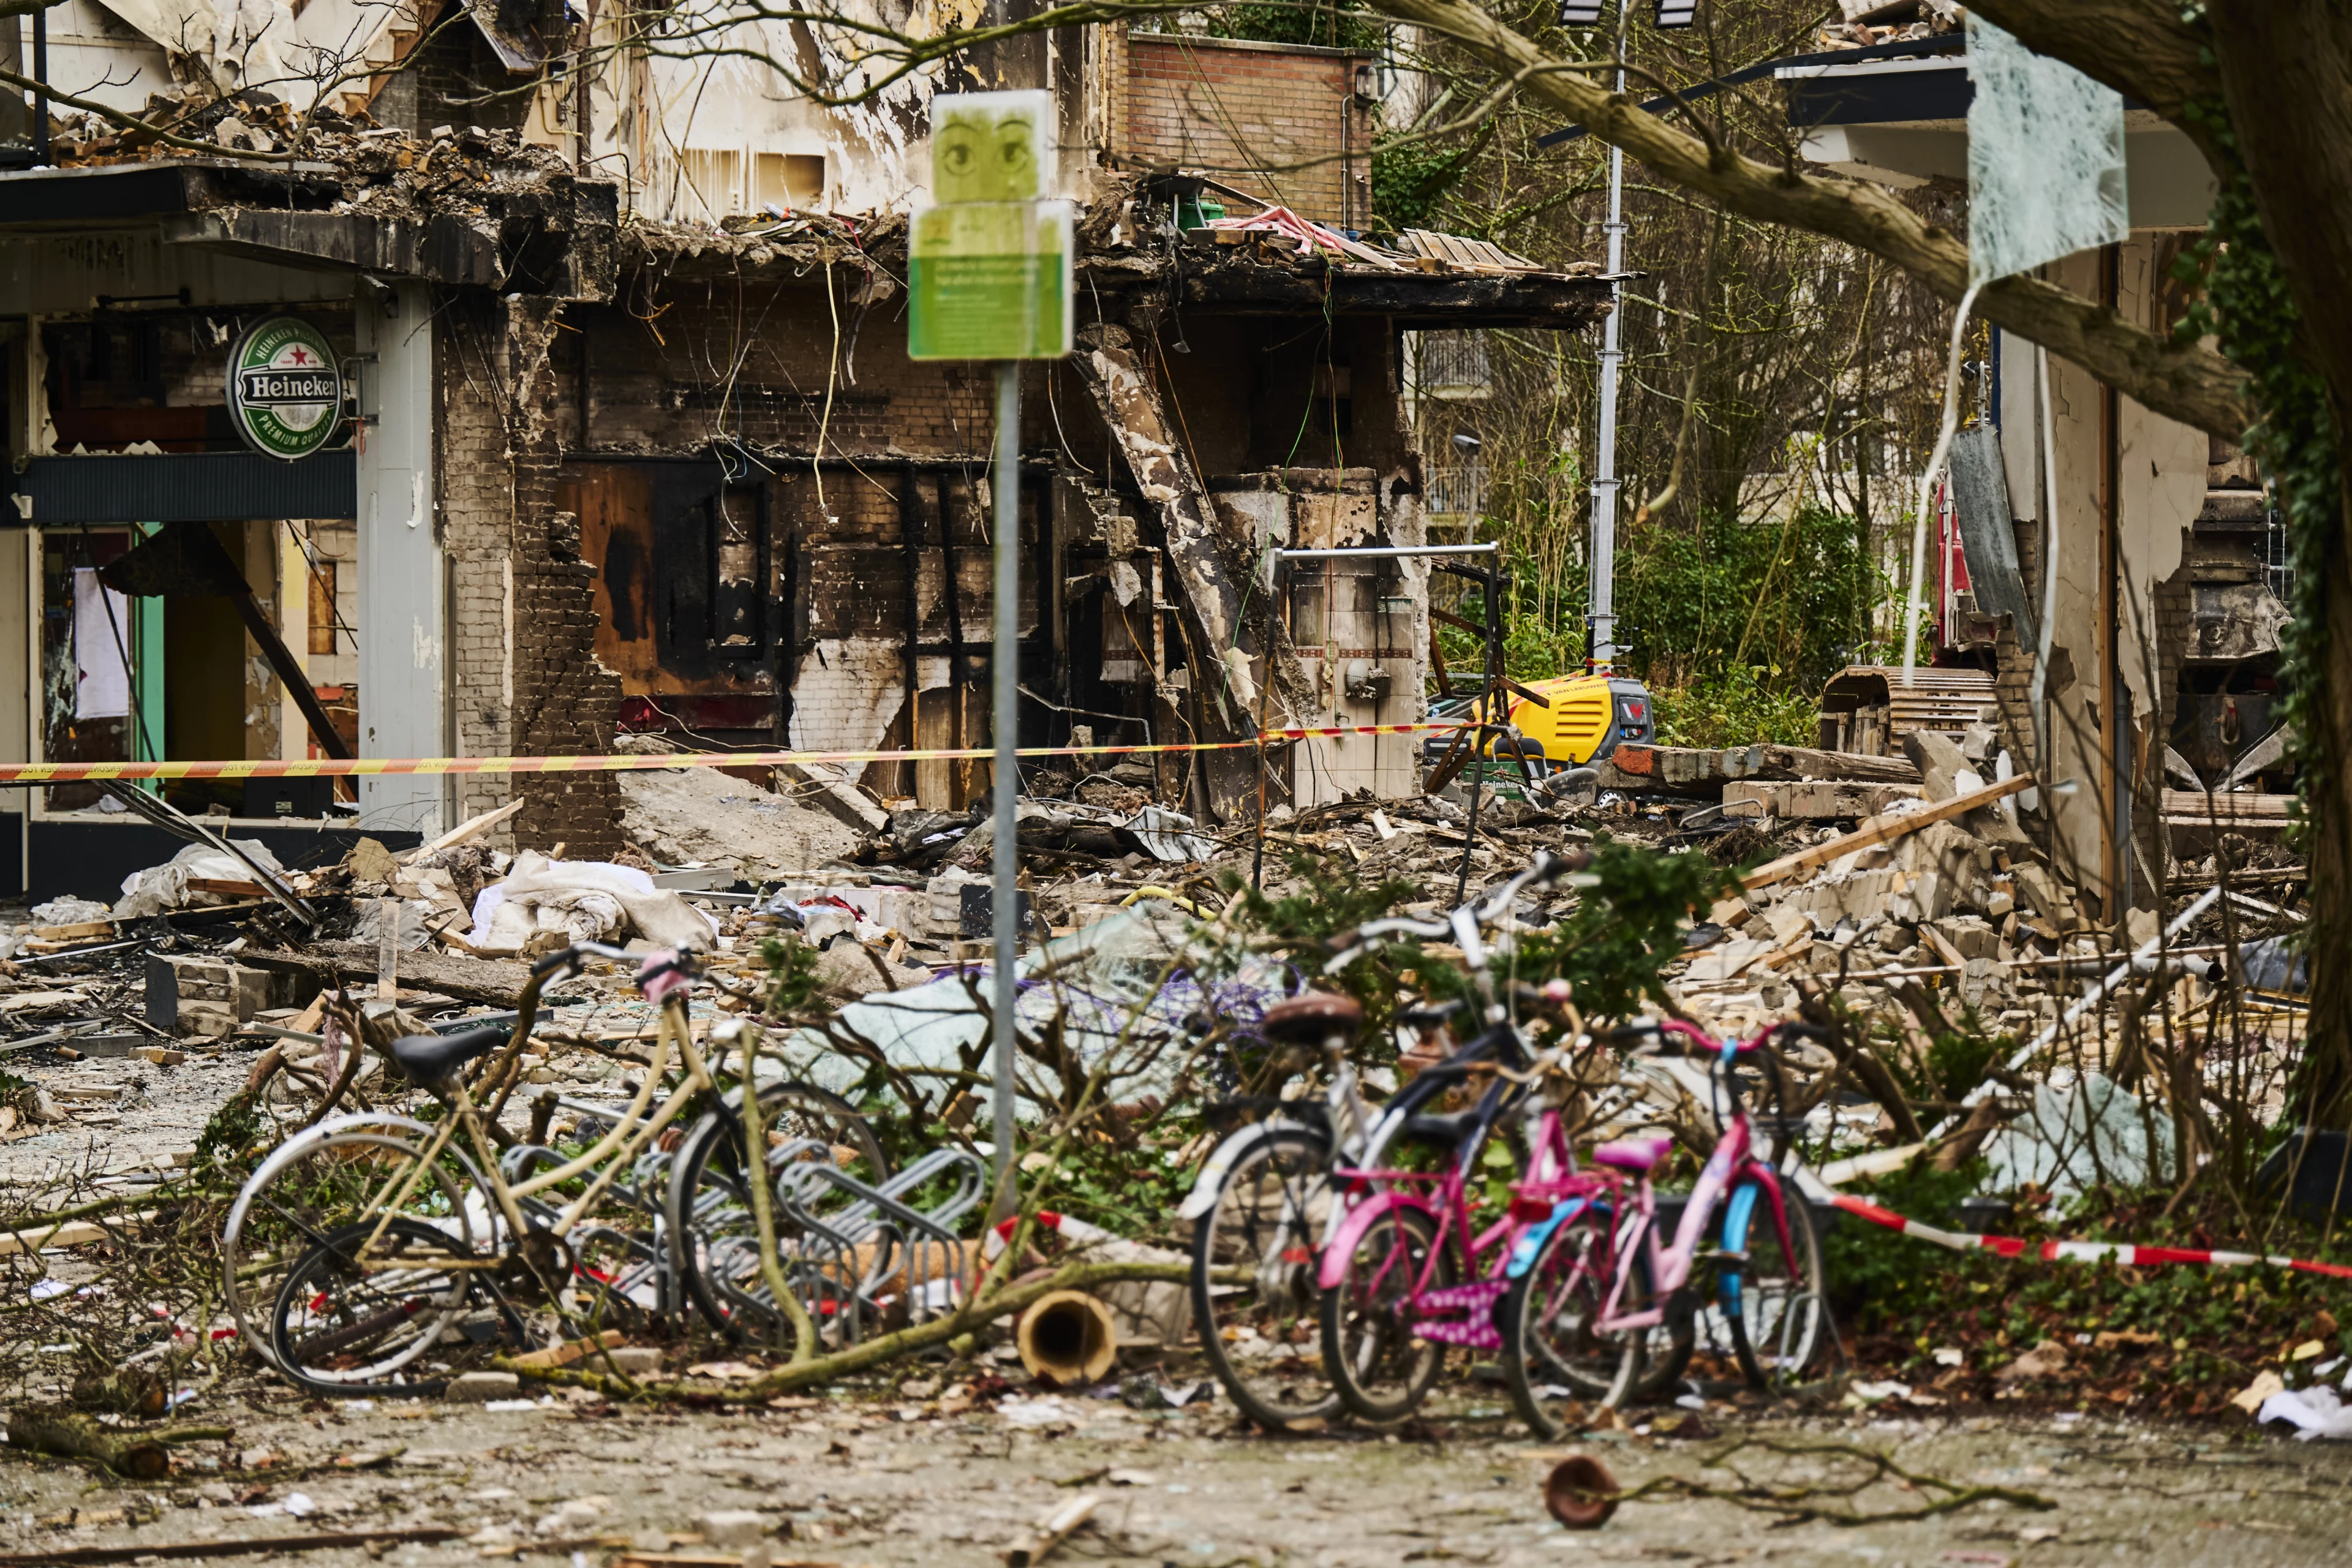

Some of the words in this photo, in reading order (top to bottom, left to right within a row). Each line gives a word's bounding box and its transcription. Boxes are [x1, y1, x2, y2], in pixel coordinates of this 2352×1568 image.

[256, 328, 292, 360] HEINEKEN
[252, 375, 336, 397] Heineken
[258, 415, 298, 446] PREMIUM
[301, 415, 331, 445] QUALITY
